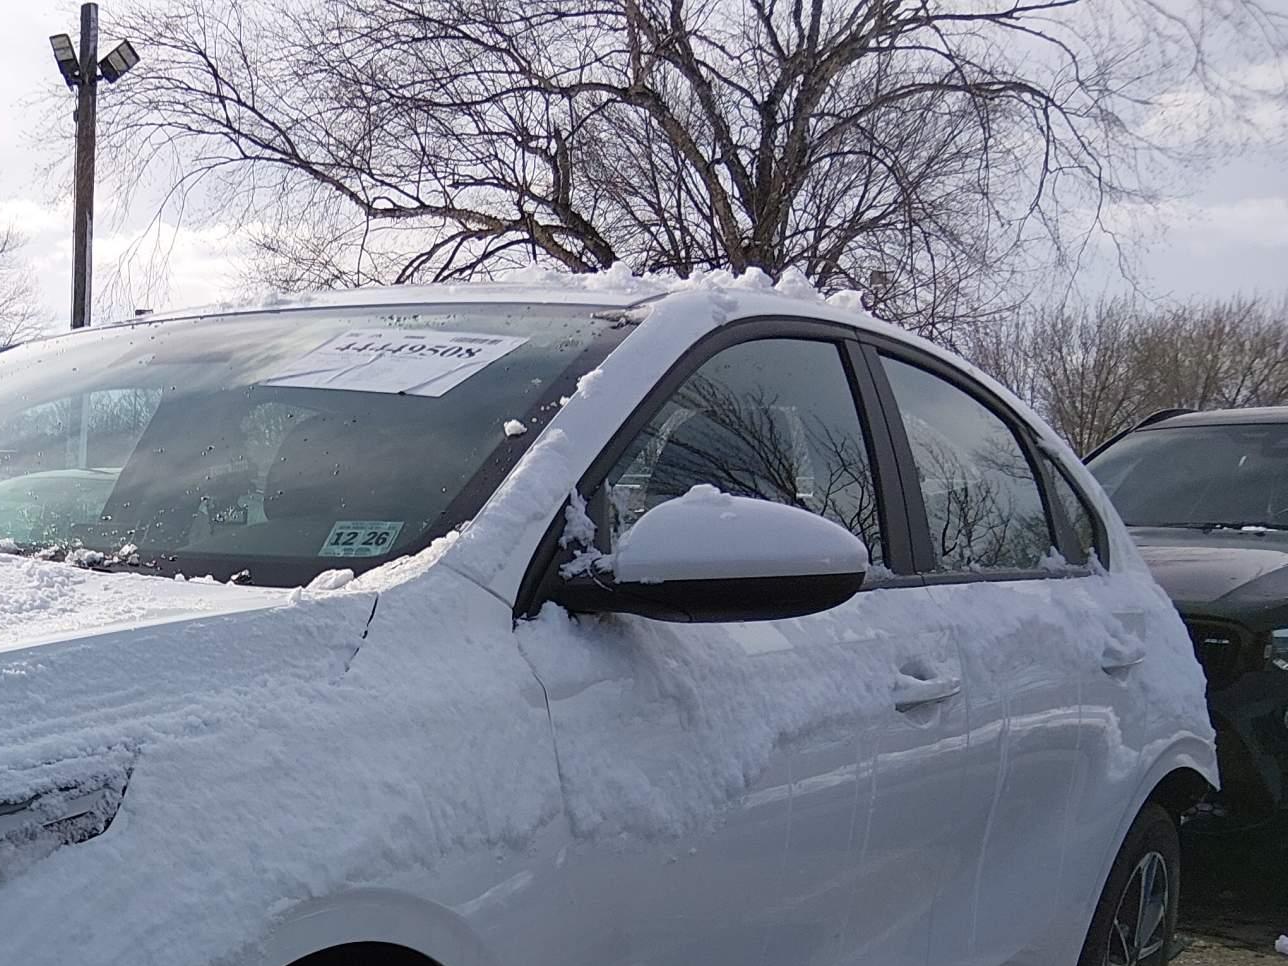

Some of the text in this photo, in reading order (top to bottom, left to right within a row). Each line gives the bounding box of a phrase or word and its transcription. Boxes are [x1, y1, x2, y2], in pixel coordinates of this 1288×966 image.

[335, 341, 483, 360] 44449508
[331, 531, 390, 546] 12 26
